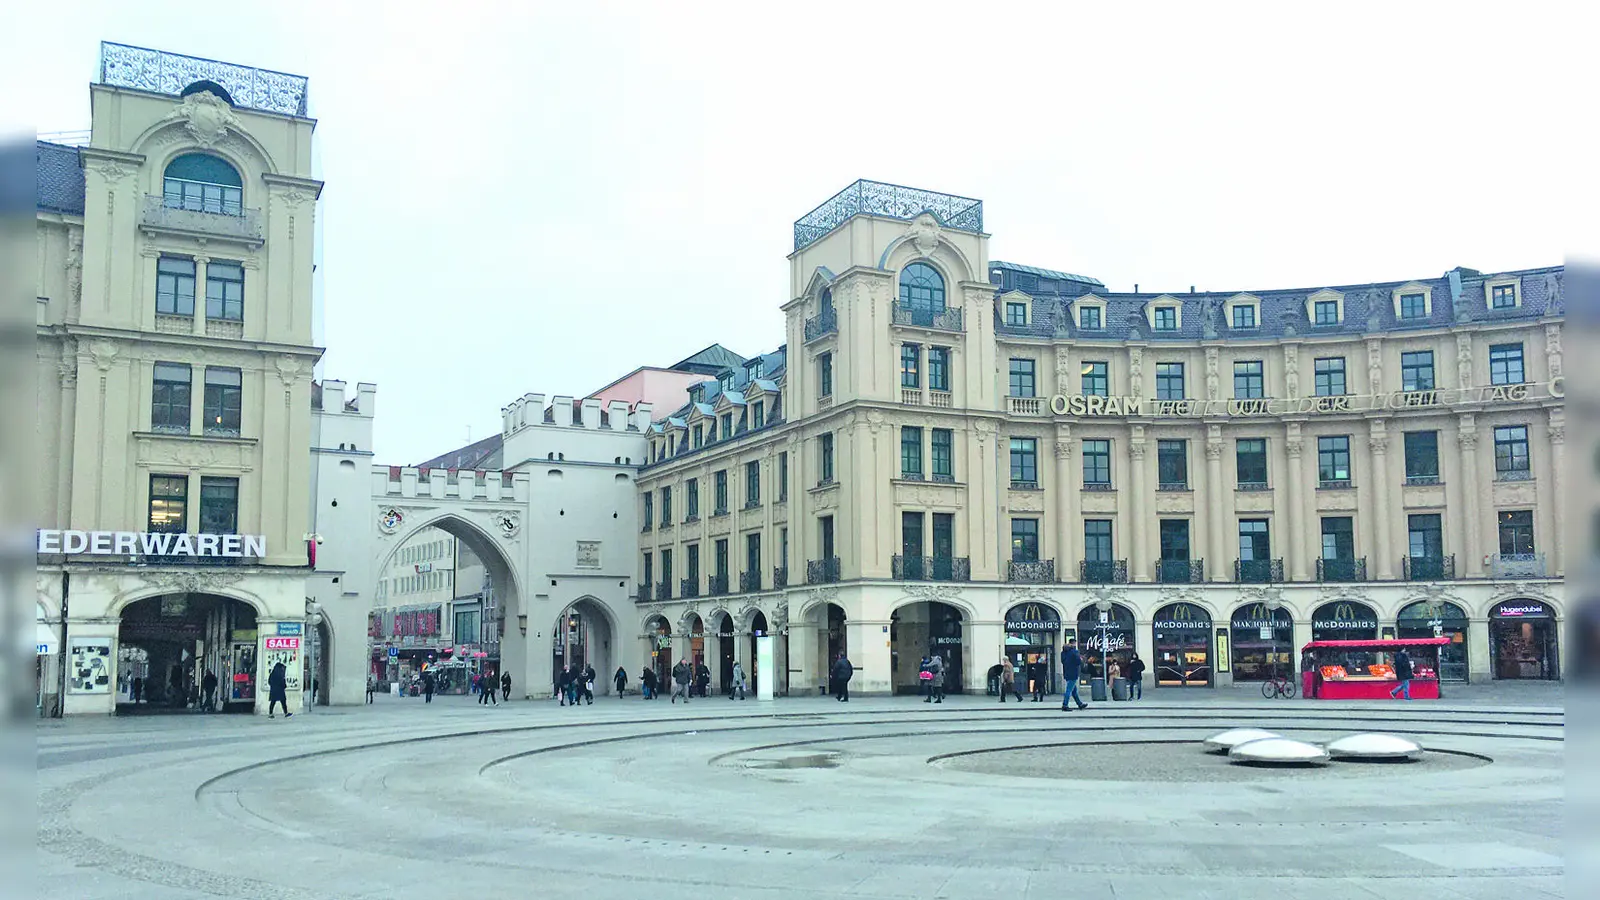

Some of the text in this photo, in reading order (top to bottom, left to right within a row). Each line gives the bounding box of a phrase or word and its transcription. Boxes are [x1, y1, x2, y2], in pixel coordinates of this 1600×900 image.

[1050, 394, 1142, 416] OSRAM
[1159, 400, 1213, 416] HELL
[1227, 400, 1282, 416] WIE
[1298, 396, 1352, 413] DER
[1478, 384, 1529, 402] TAG
[38, 529, 266, 558] EDERWAREN
[1500, 606, 1543, 614] Hugendubel
[1007, 621, 1060, 629] McDonald's
[1154, 621, 1211, 629] McDonald's
[1314, 620, 1376, 629] McDonald's
[268, 639, 297, 648] SALE
[390, 648, 397, 656] U
